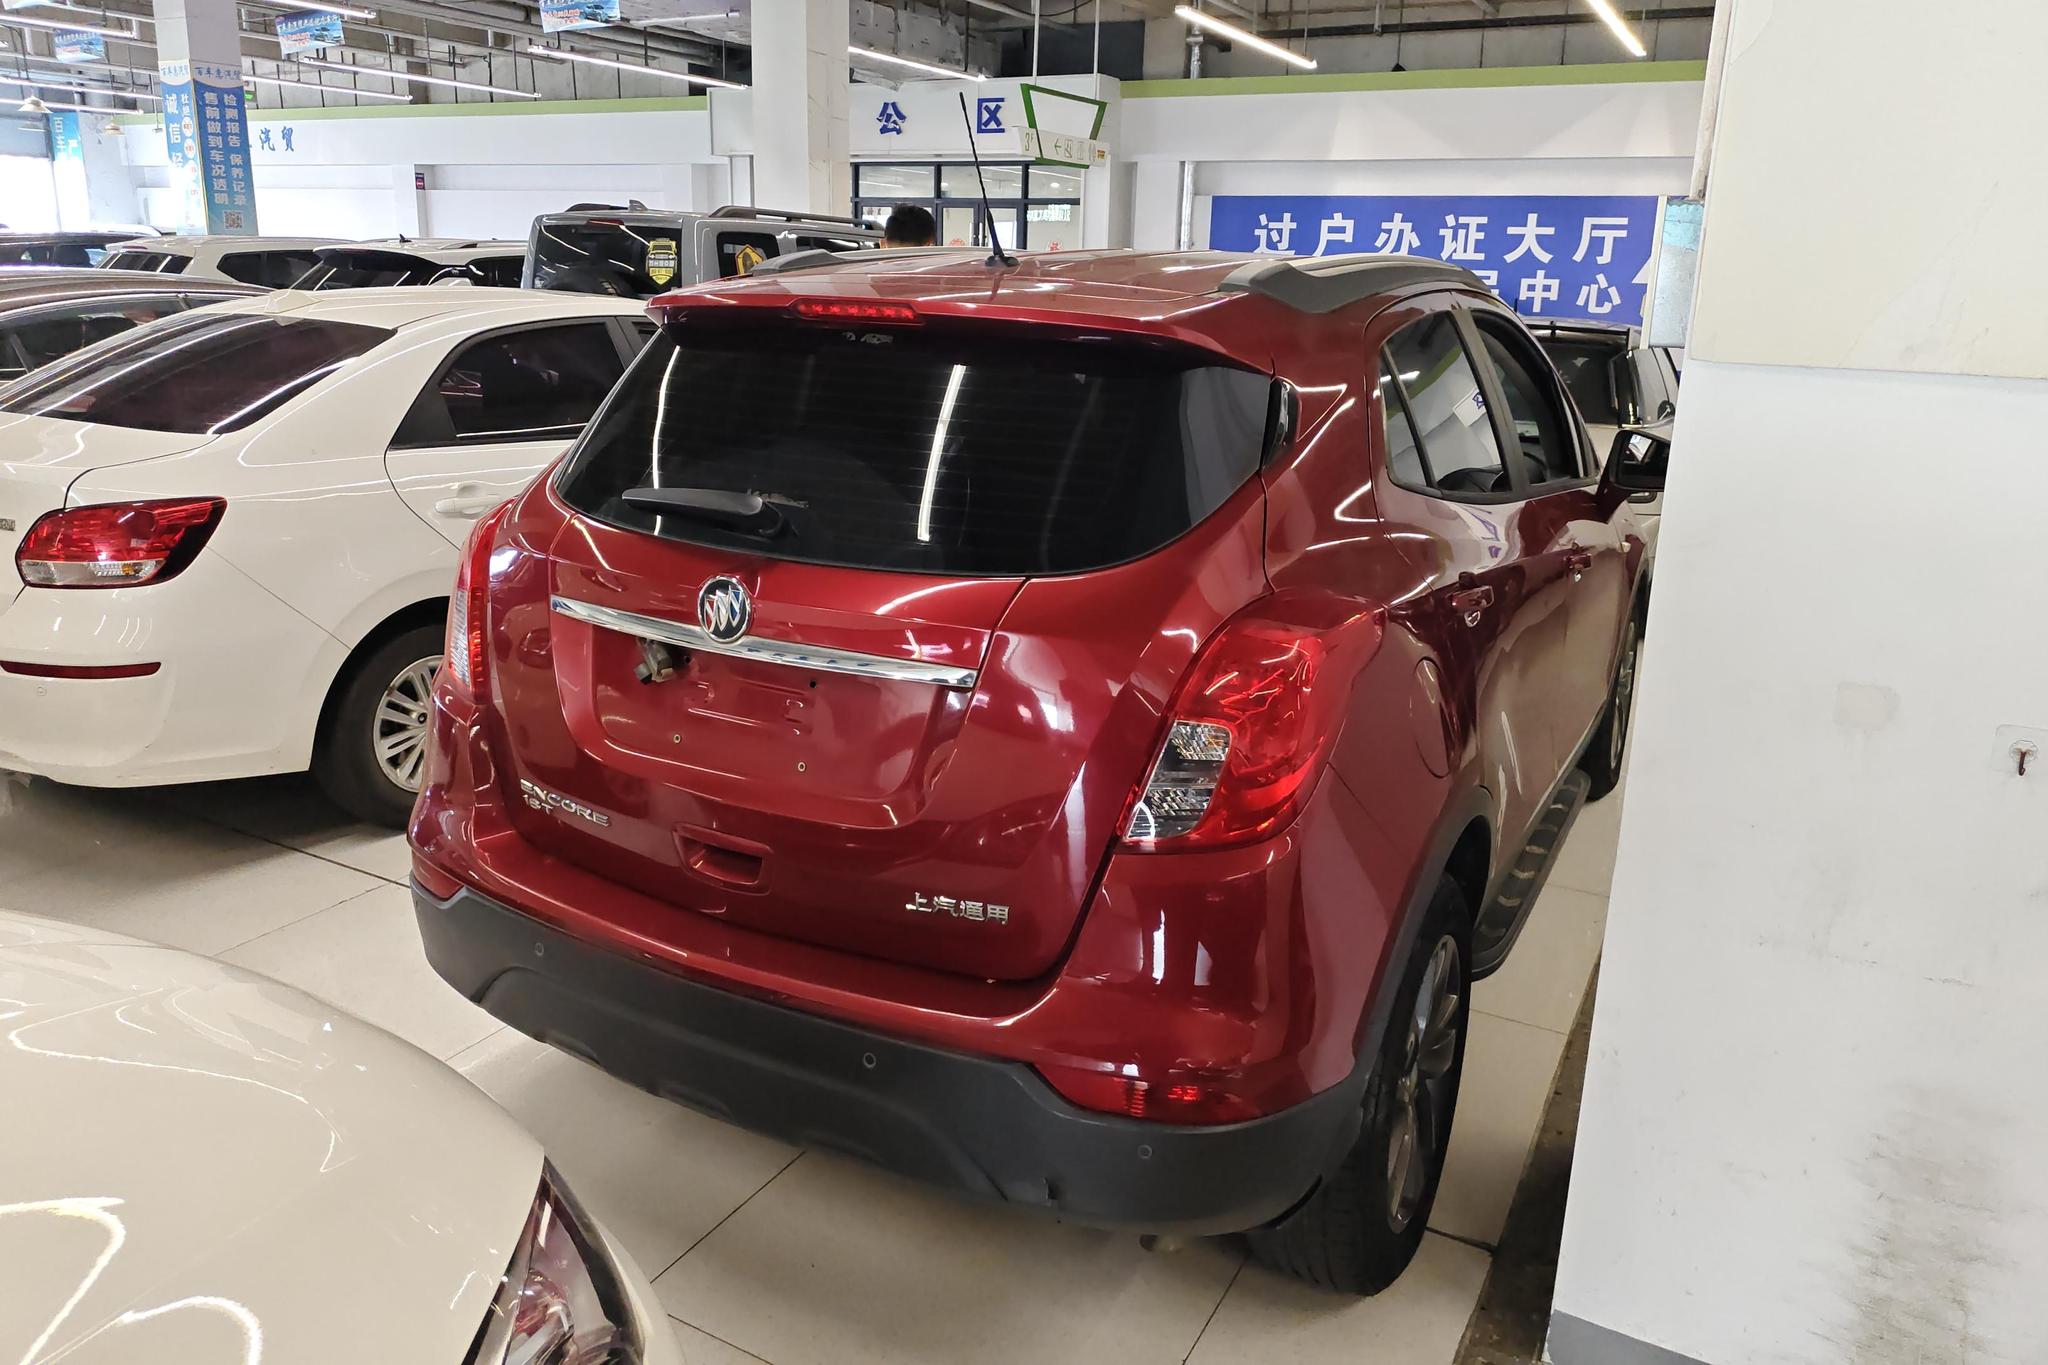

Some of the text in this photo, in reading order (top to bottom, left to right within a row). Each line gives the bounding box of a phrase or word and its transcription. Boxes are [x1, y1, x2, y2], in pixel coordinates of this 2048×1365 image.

[223, 94, 241, 148] 检测报告
[203, 91, 229, 205] 售前做到车况透明
[1253, 212, 1629, 264] 过户办证大厅
[520, 778, 609, 828] ENCORE
[904, 891, 1010, 925] 上汽通用
